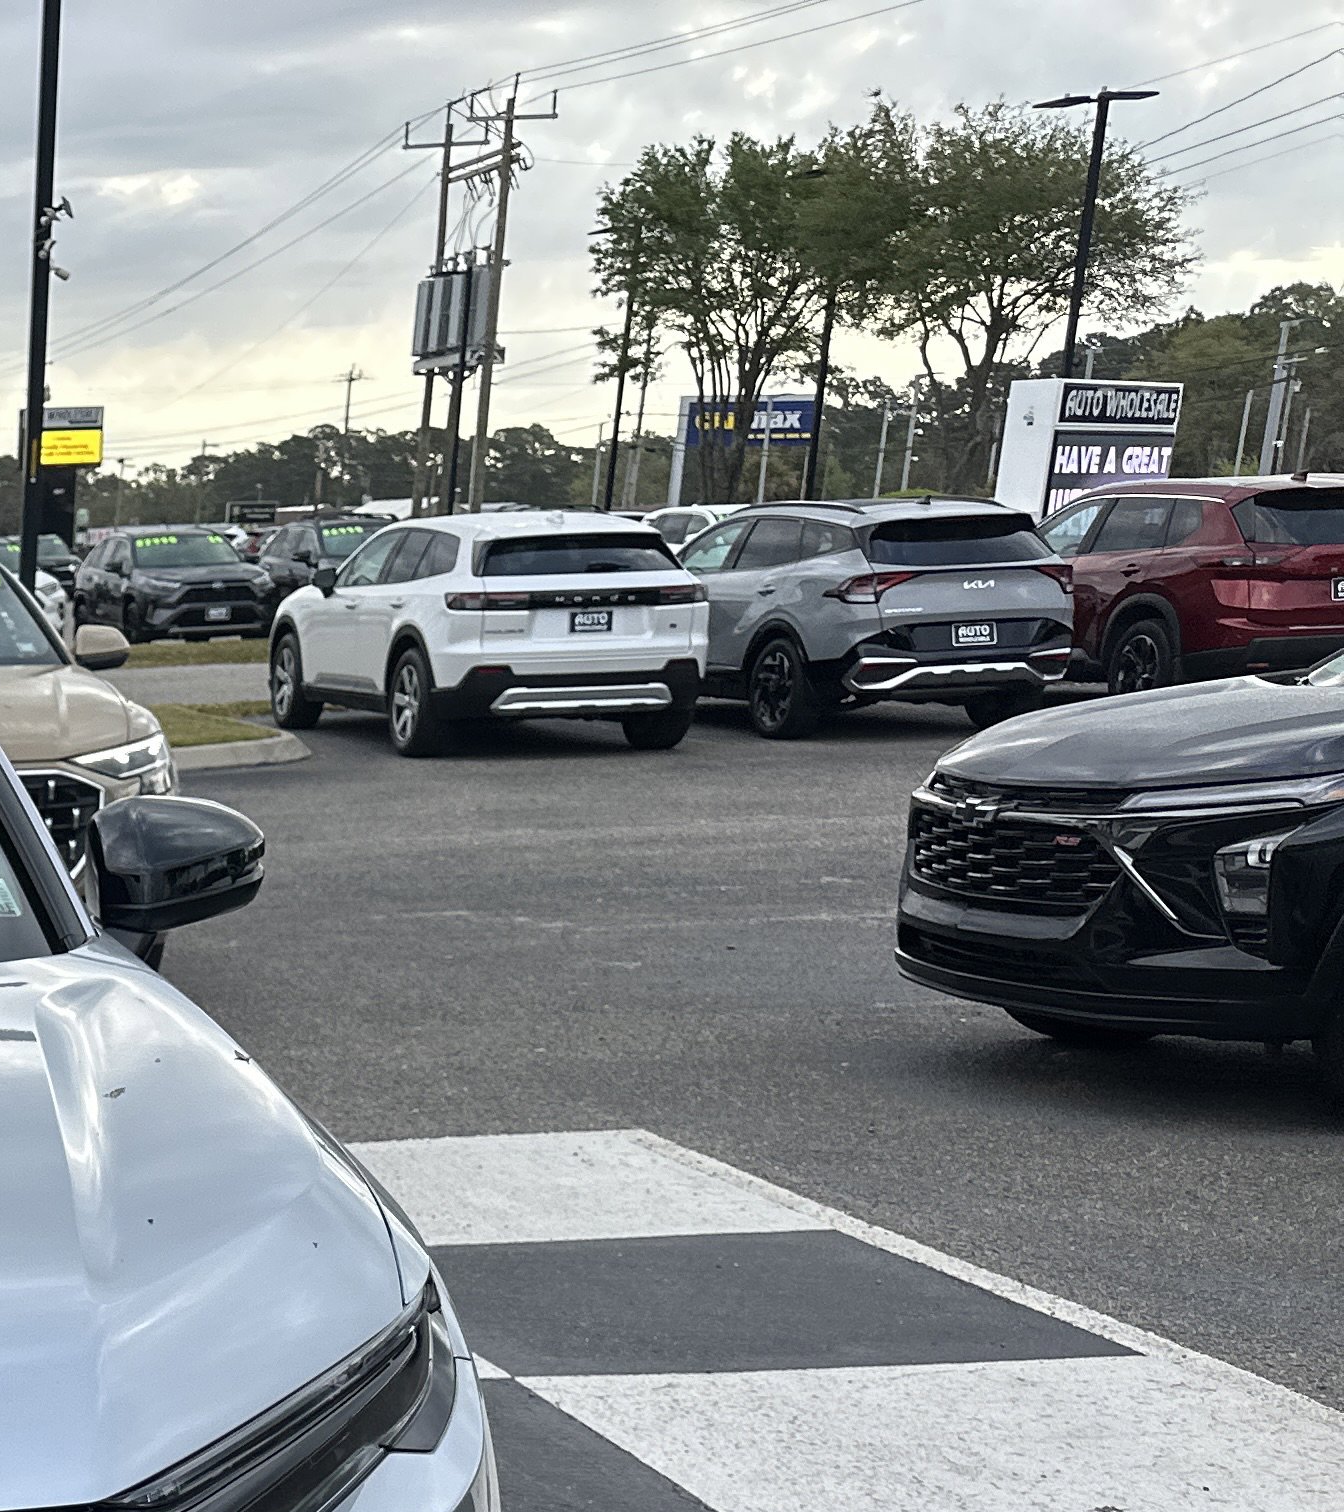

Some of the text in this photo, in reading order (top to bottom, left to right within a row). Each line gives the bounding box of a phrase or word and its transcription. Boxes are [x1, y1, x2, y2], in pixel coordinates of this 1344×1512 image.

[1065, 389, 1178, 420] AUTO WHOLESALE
[1054, 446, 1172, 474] HAVE A GREAT
[574, 612, 608, 626] AUTO
[958, 624, 990, 637] AUTO
